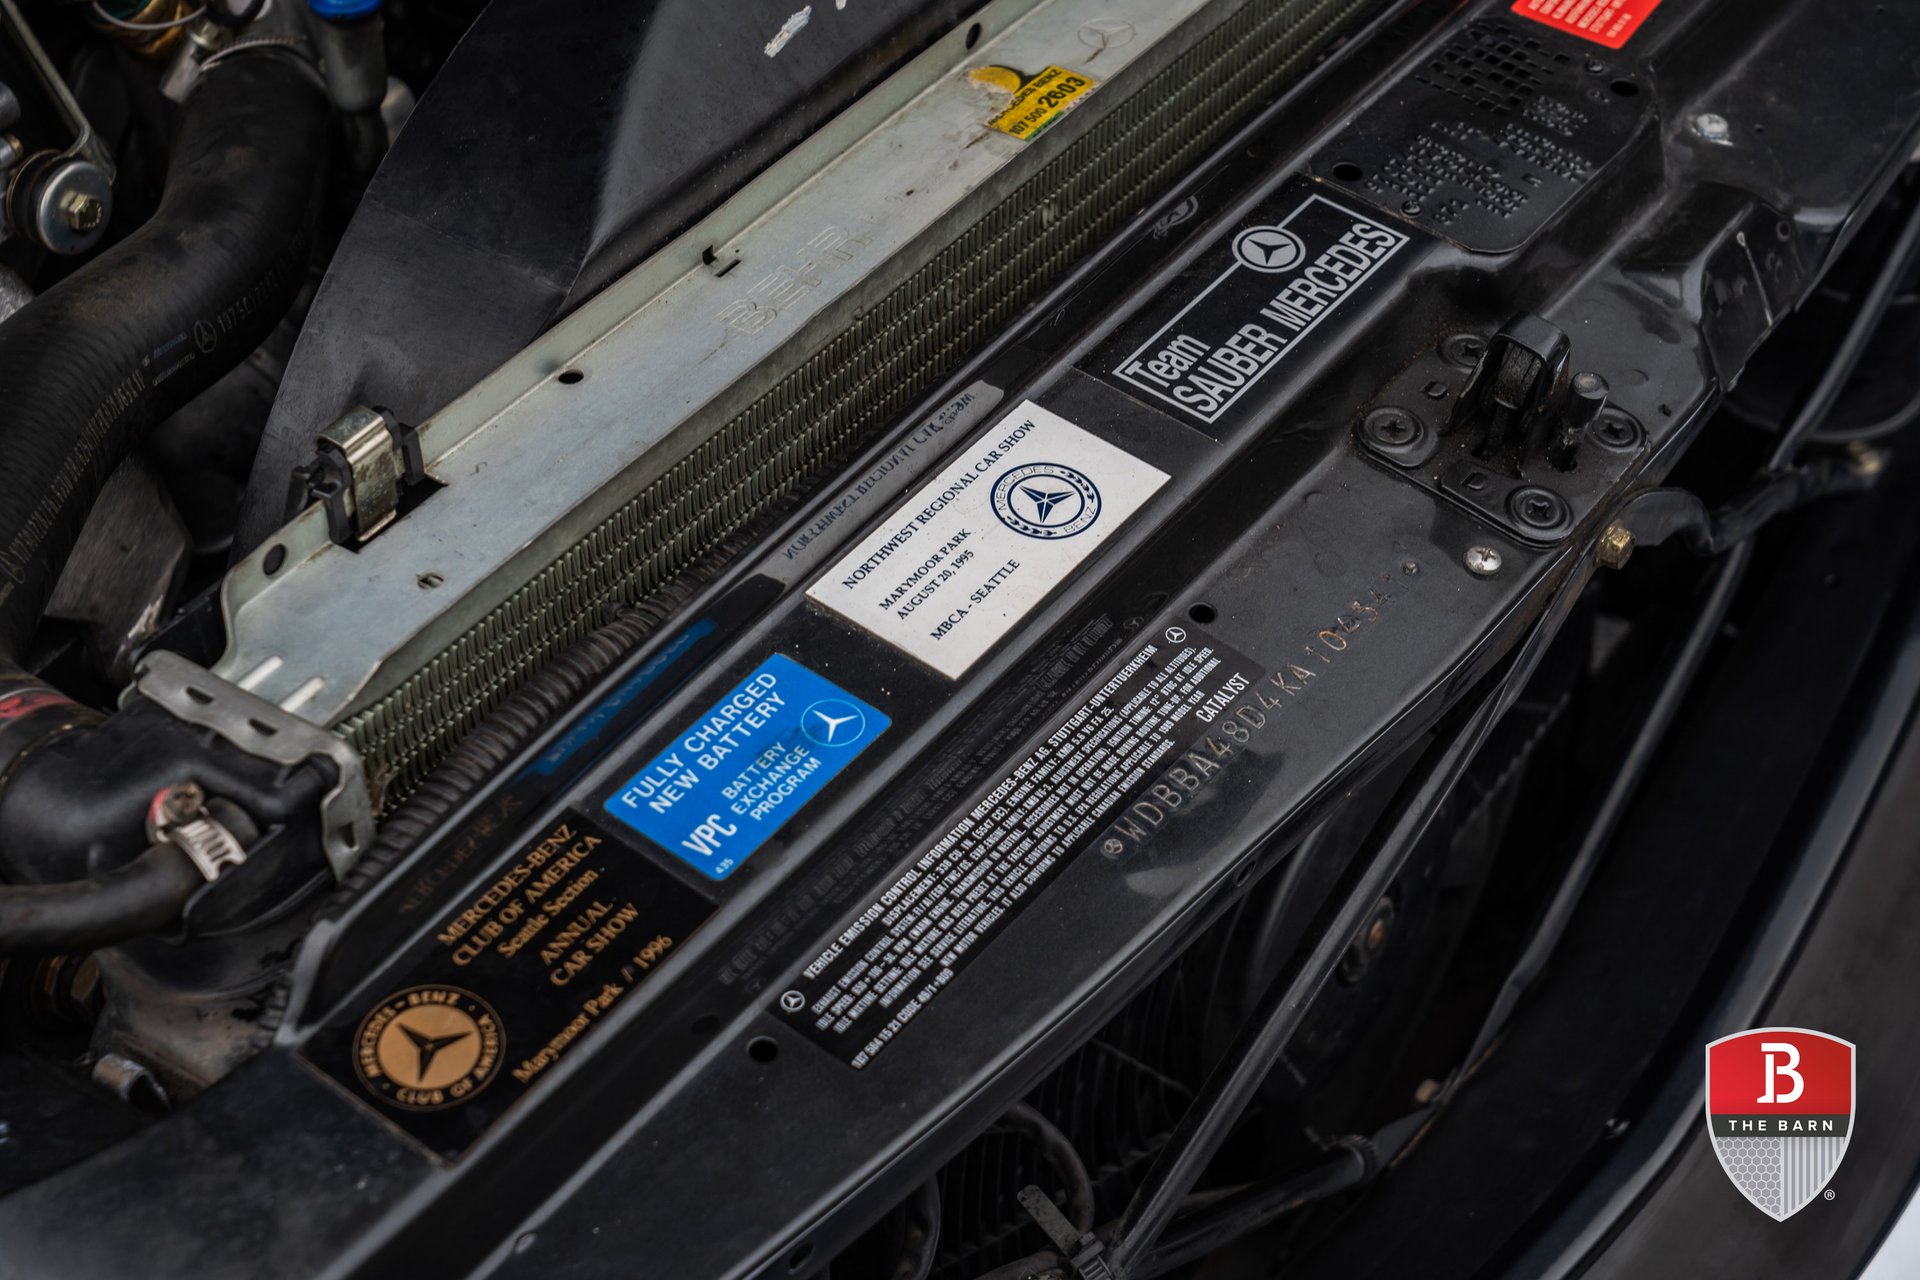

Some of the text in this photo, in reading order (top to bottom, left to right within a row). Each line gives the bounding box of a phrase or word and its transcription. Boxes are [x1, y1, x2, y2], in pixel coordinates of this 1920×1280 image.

[1024, 107, 1047, 123] 500
[1038, 76, 1085, 109] 2603
[712, 224, 873, 335] BEHR
[1173, 217, 1395, 412] SAUBER MERCEDES
[1124, 334, 1210, 387] Team
[842, 419, 1035, 589] NORTHWEST REGIONAL CAR SHOW
[996, 466, 1054, 511] MERCEDES
[1063, 506, 1096, 533] BENZ
[878, 529, 971, 610] MARYMOOR PARK
[897, 549, 973, 619] AUGUST 20, 1995
[930, 559, 1020, 640] MBCA SEATTLE
[1050, 751, 1085, 784] ADJUSTMENT
[1147, 680, 1159, 689] TO
[1155, 672, 1169, 683] ALL
[1055, 782, 1071, 796] NOT
[1067, 775, 1079, 785] IN
[1174, 672, 1185, 682] AT
[1195, 672, 1249, 722] CATALYST
[621, 752, 683, 808] FULLY
[684, 673, 776, 752] CHARGED
[649, 769, 699, 813] NEW
[697, 691, 785, 770] BATTERY
[721, 742, 785, 799] BATTERY
[730, 745, 809, 814] EXCHANGE
[750, 757, 821, 820] PROGRAM
[803, 644, 1157, 978] VEHICLE EMISSION CONTROL INFORMATION MERCEDES-BENZ AG. STUTTGART-UNTERTUERKHEIM
[882, 873, 939, 925] DISPLACEMENT:
[948, 849, 965, 861] CU.
[971, 818, 994, 839] (5547
[991, 806, 1010, 821] CC).
[1005, 780, 1034, 807] ENGINE
[1030, 757, 1060, 783] FAMILY:
[1056, 742, 1074, 759] KMB
[1071, 732, 1085, 745] 5.6
[1090, 715, 1103, 726] FA
[1100, 706, 1114, 717] 25.
[986, 871, 998, 883] AT
[995, 860, 1011, 873] THE
[1081, 776, 1096, 790] NOT
[1001, 863, 1028, 887] VEHICLE
[1024, 834, 1057, 864] CONFORMS
[1053, 825, 1066, 835] TO
[1149, 732, 1161, 742] TO
[682, 814, 737, 855] VPC
[715, 858, 733, 873] 435
[1051, 845, 1064, 856] TO
[437, 824, 576, 944] MERCEDES-BENZ
[452, 836, 601, 965] CLUB OF AMERICA
[497, 870, 598, 957] Seattle Section
[541, 901, 613, 964] ANNUAL
[550, 903, 638, 985] CAR SHOW
[513, 1013, 589, 1081] Marymoor
[583, 984, 623, 1015] Park
[633, 935, 672, 968] 1996
[896, 999, 921, 1022] CODE
[396, 1014, 498, 1105] CLUB OF AMERICA
